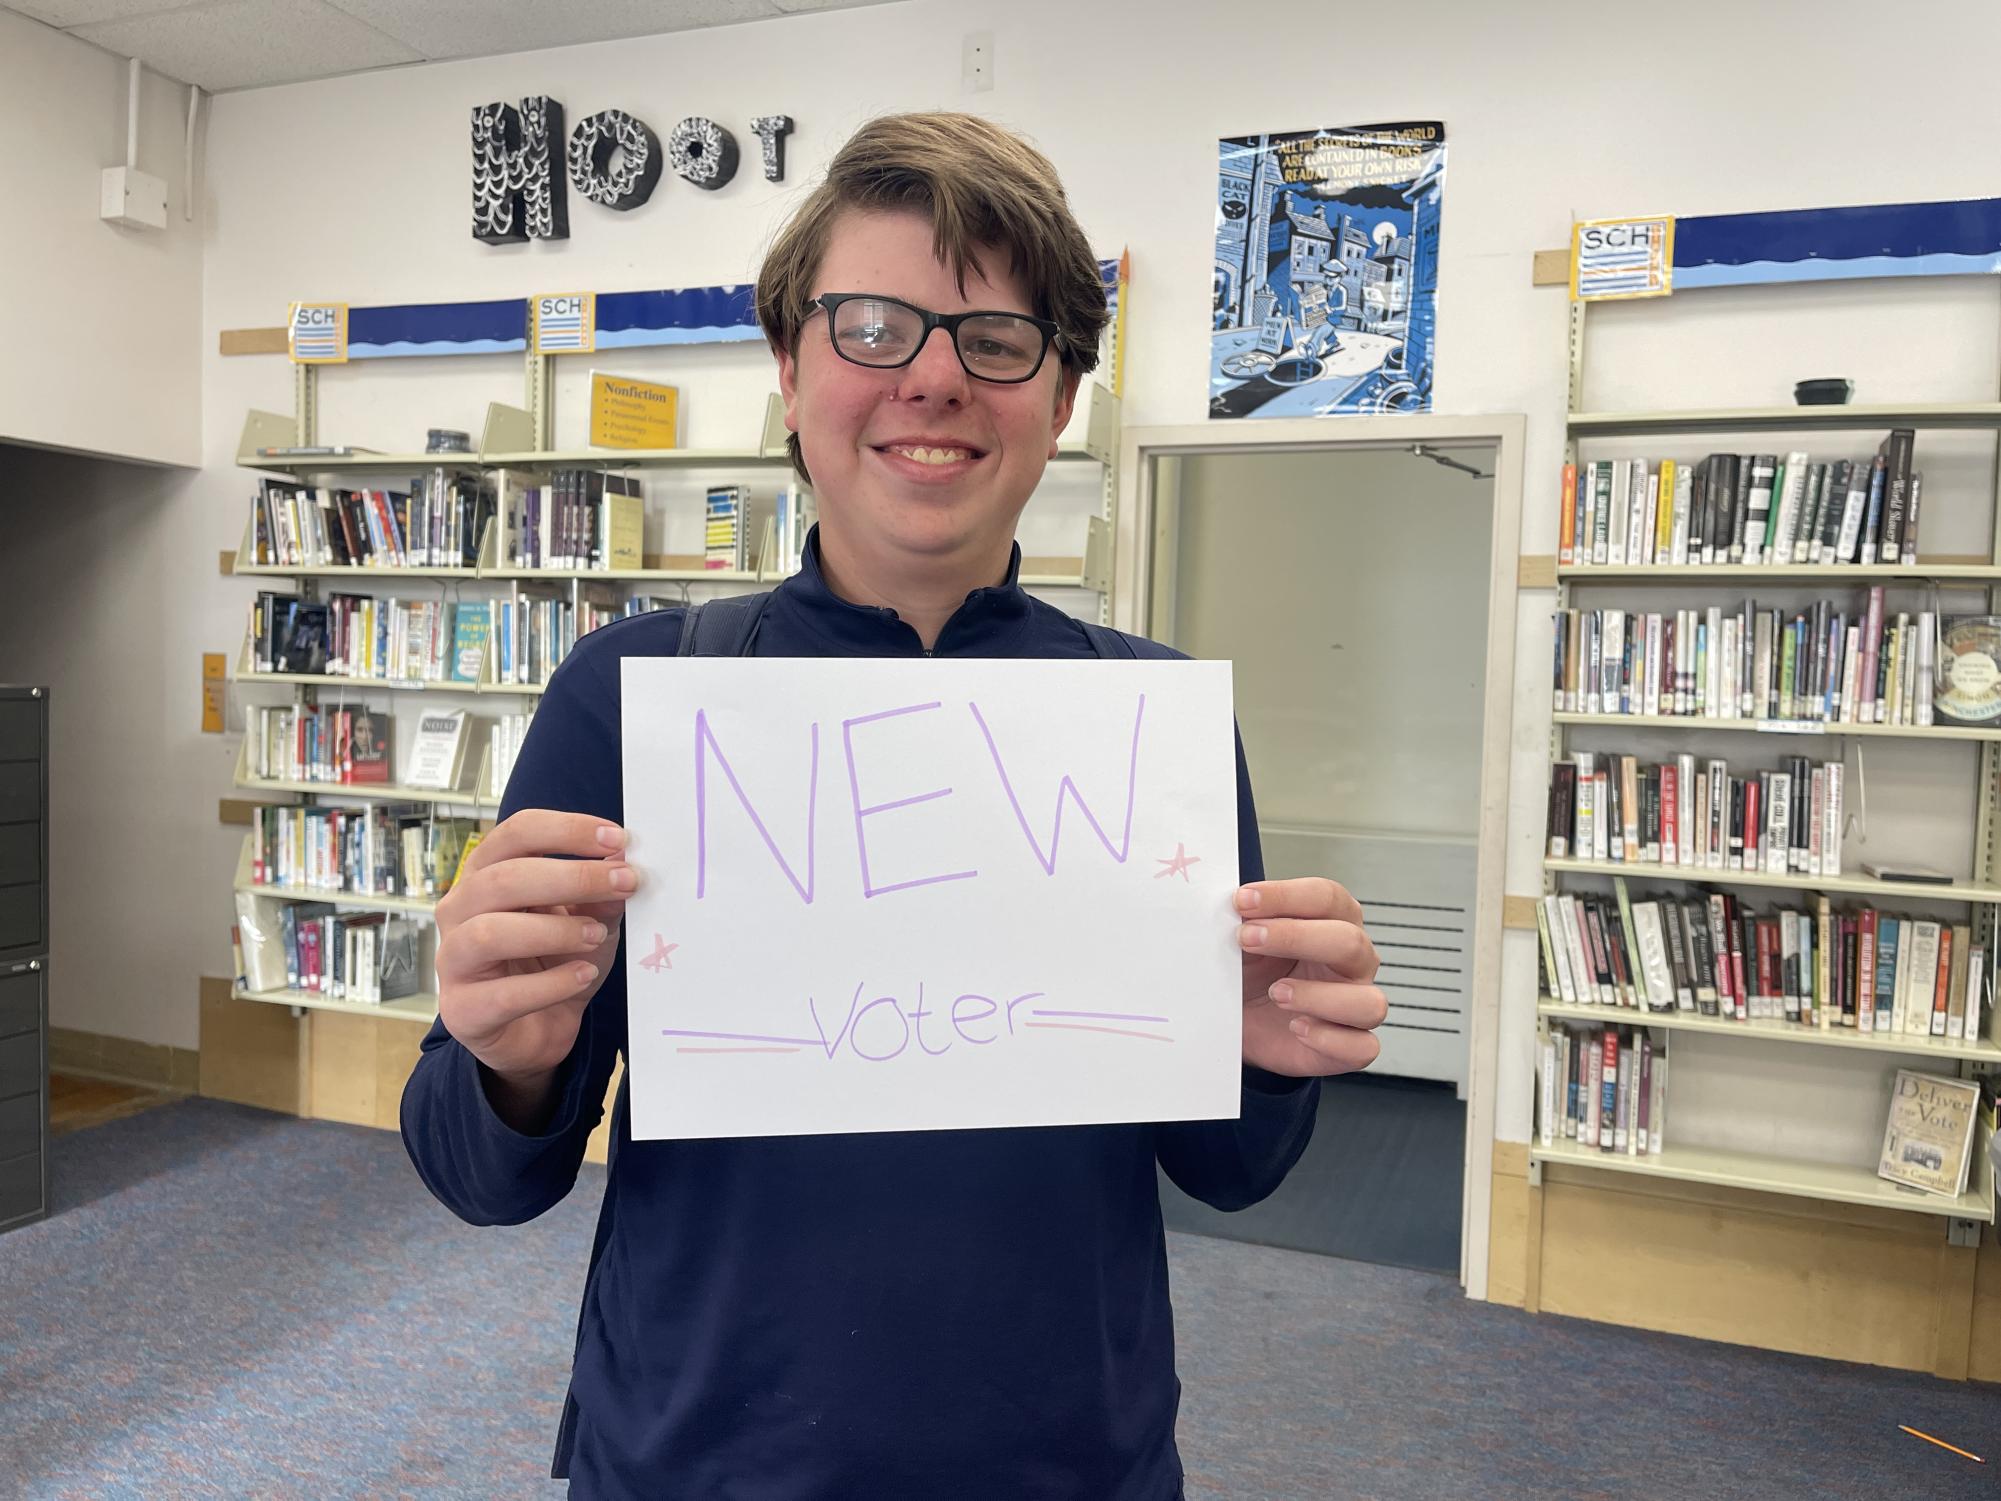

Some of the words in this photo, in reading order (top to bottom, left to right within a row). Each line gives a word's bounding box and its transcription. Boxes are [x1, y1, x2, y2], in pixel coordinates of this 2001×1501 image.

[1394, 127, 1436, 141] WORLD
[471, 95, 794, 246] HOOT
[1284, 168, 1314, 183] READ
[1332, 163, 1363, 179] YOUR
[1365, 160, 1393, 177] OWN
[1221, 179, 1252, 192] BLACK
[1222, 190, 1249, 201] CAT
[1584, 226, 1649, 249] SCH
[297, 308, 336, 325] SCH
[540, 298, 582, 315] SCH
[604, 381, 667, 403] Nonfiction
[693, 693, 1147, 905] NEW
[809, 981, 1046, 1062] Voter
[1899, 1076, 1973, 1112] Deliver
[1917, 1102, 1959, 1132] Vote
